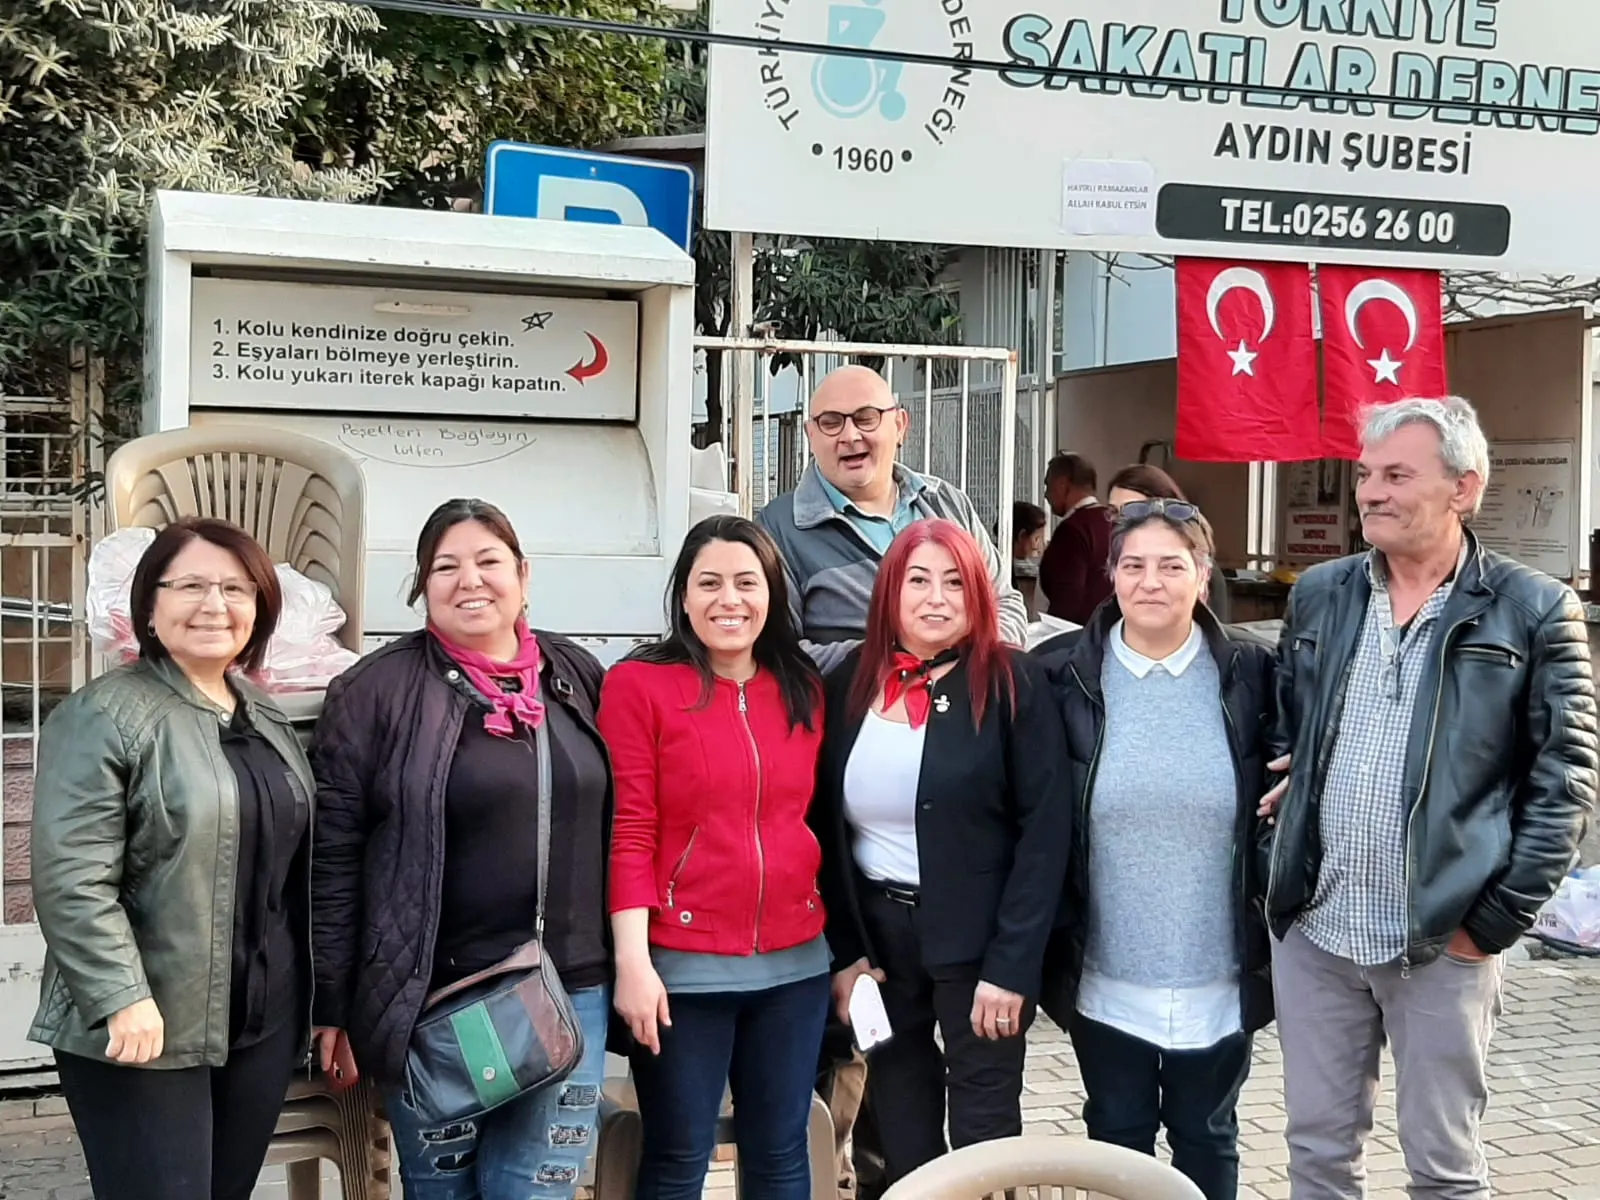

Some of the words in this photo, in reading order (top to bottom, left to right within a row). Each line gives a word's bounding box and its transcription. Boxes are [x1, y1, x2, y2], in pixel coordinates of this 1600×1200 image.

[755, 0, 800, 131] TÜRKİY
[998, 13, 1377, 115] SAKATLAR
[1388, 51, 1600, 135] DERNE
[832, 145, 894, 173] 1960
[1213, 121, 1331, 165] AYDIN
[1340, 131, 1472, 175] ŞUBESİ
[1067, 199, 1094, 208] ALLAH
[1221, 198, 1367, 239] TEL:0256
[1374, 209, 1411, 241] 26
[1418, 211, 1455, 243] 00
[213, 318, 230, 335] 1.
[237, 319, 285, 337] Kolu
[291, 322, 388, 342] kendinize
[394, 327, 451, 347] doğru
[458, 331, 515, 349] çekin.
[212, 341, 230, 356] 2.
[237, 342, 319, 362] Eşyaları
[326, 346, 411, 367] bölmeye
[417, 351, 519, 370] yerleştirin.
[212, 364, 230, 379] 3.
[237, 364, 285, 381] Kolu
[291, 367, 353, 385] yukarı
[360, 369, 415, 386] iterek
[421, 371, 485, 392] kapağı
[492, 374, 566, 393] kapatın.
